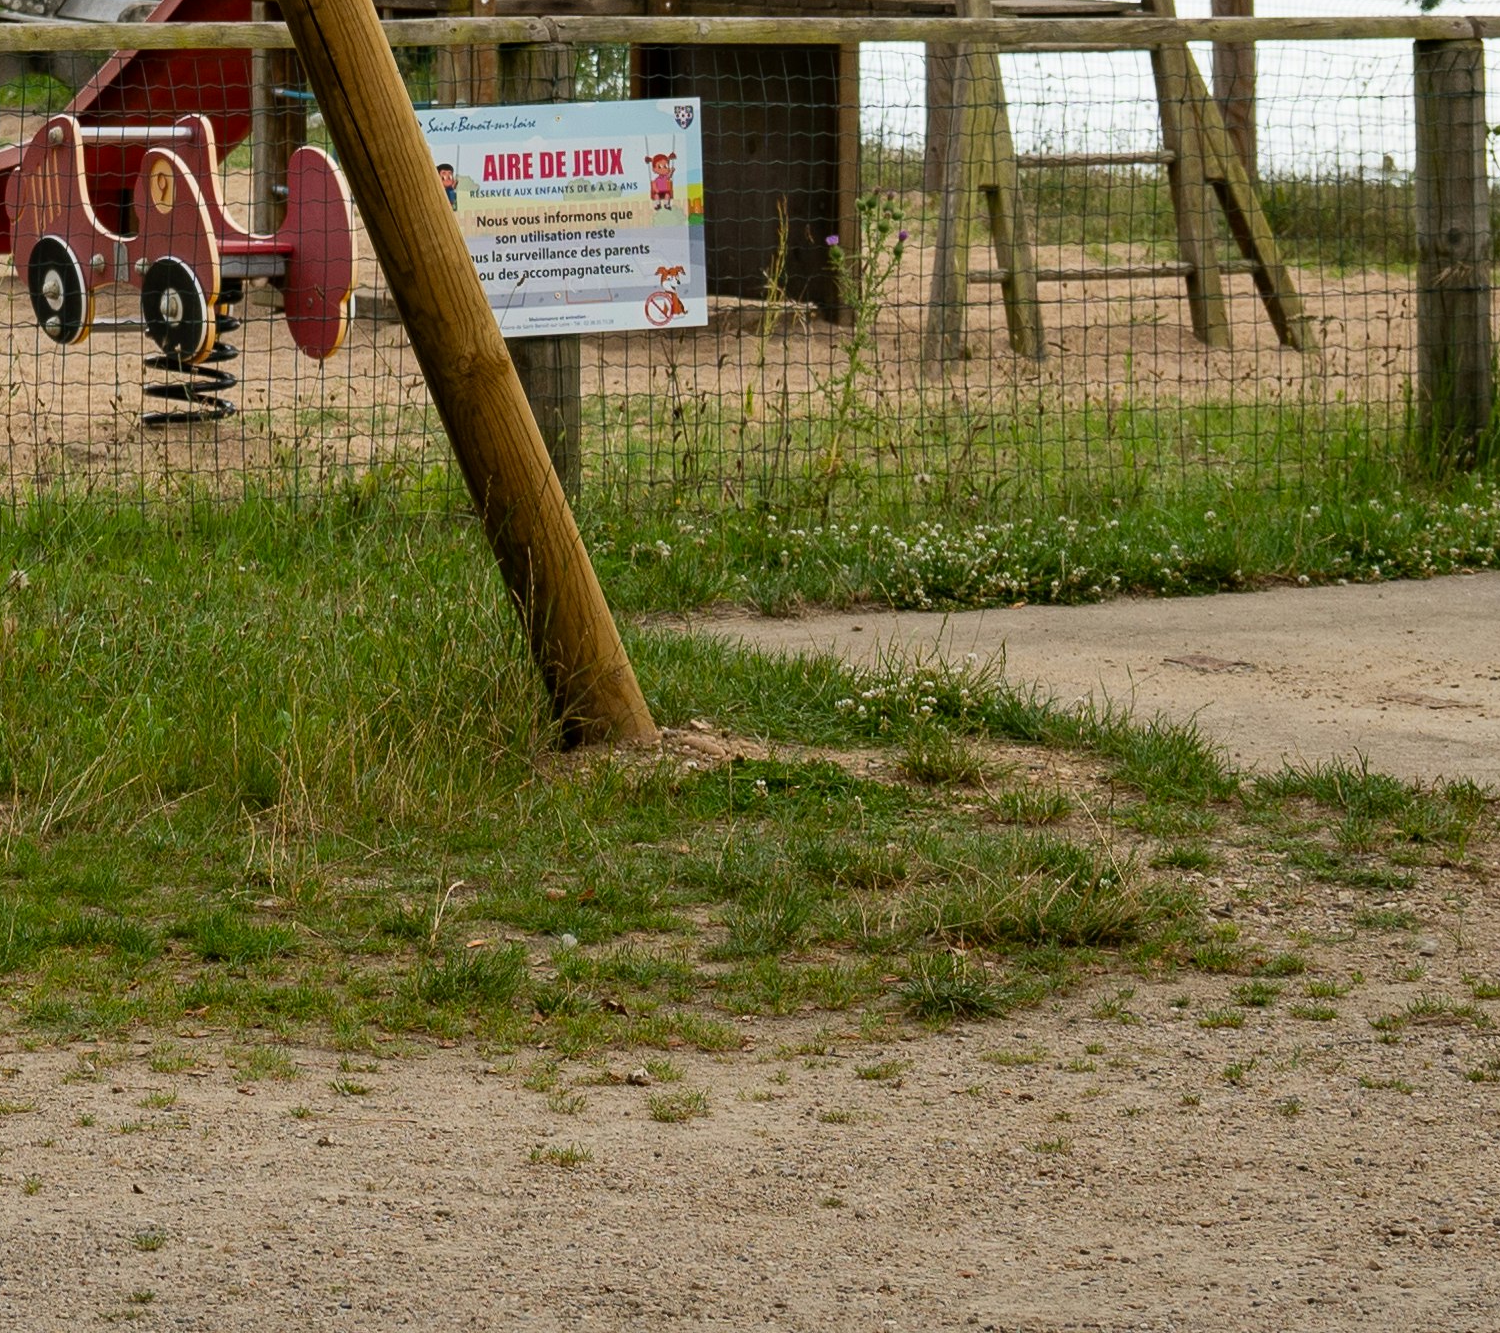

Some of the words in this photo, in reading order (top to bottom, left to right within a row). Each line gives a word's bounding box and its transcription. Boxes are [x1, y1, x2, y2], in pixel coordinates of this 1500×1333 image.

[483, 152, 534, 182] AIRE
[540, 150, 567, 180] DE
[572, 148, 624, 177] JEUX
[470, 186, 512, 199] RÉSERVÉE
[514, 188, 532, 197] AUX
[535, 185, 575, 196] ENFANTS
[577, 184, 588, 193] DE
[608, 182, 618, 192] 12
[620, 181, 638, 191] ANS
[476, 215, 508, 228] Nous
[512, 215, 540, 226] vous
[544, 210, 607, 224] informons
[610, 210, 633, 223] que
[495, 234, 517, 244] son
[520, 228, 582, 243] utilisation
[585, 228, 616, 240] reste
[492, 250, 502, 263] la
[506, 246, 578, 262] surveillance
[580, 245, 602, 258] des
[604, 244, 650, 260] parents
[479, 271, 494, 281] ou
[498, 267, 519, 281] des
[522, 263, 634, 280] accompagnateurs.
